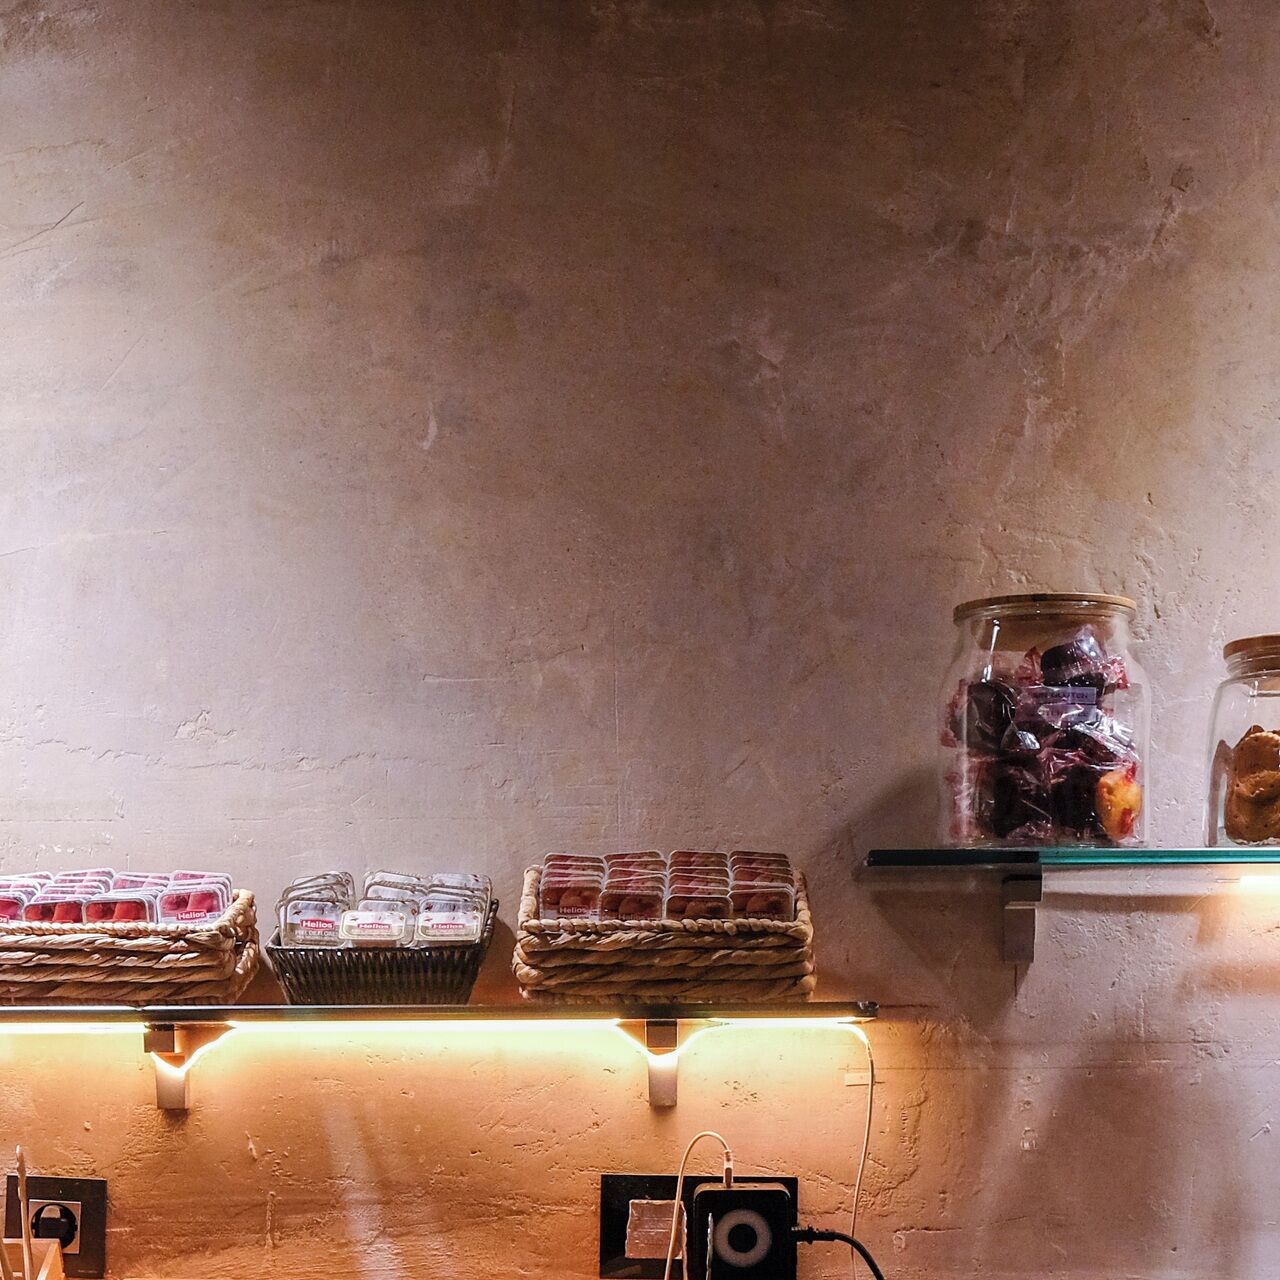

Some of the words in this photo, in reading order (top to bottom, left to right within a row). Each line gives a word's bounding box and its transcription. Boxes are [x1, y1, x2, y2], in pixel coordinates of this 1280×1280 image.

[559, 906, 587, 914] Helios
[178, 911, 206, 920] Helios
[303, 920, 332, 929] Helios
